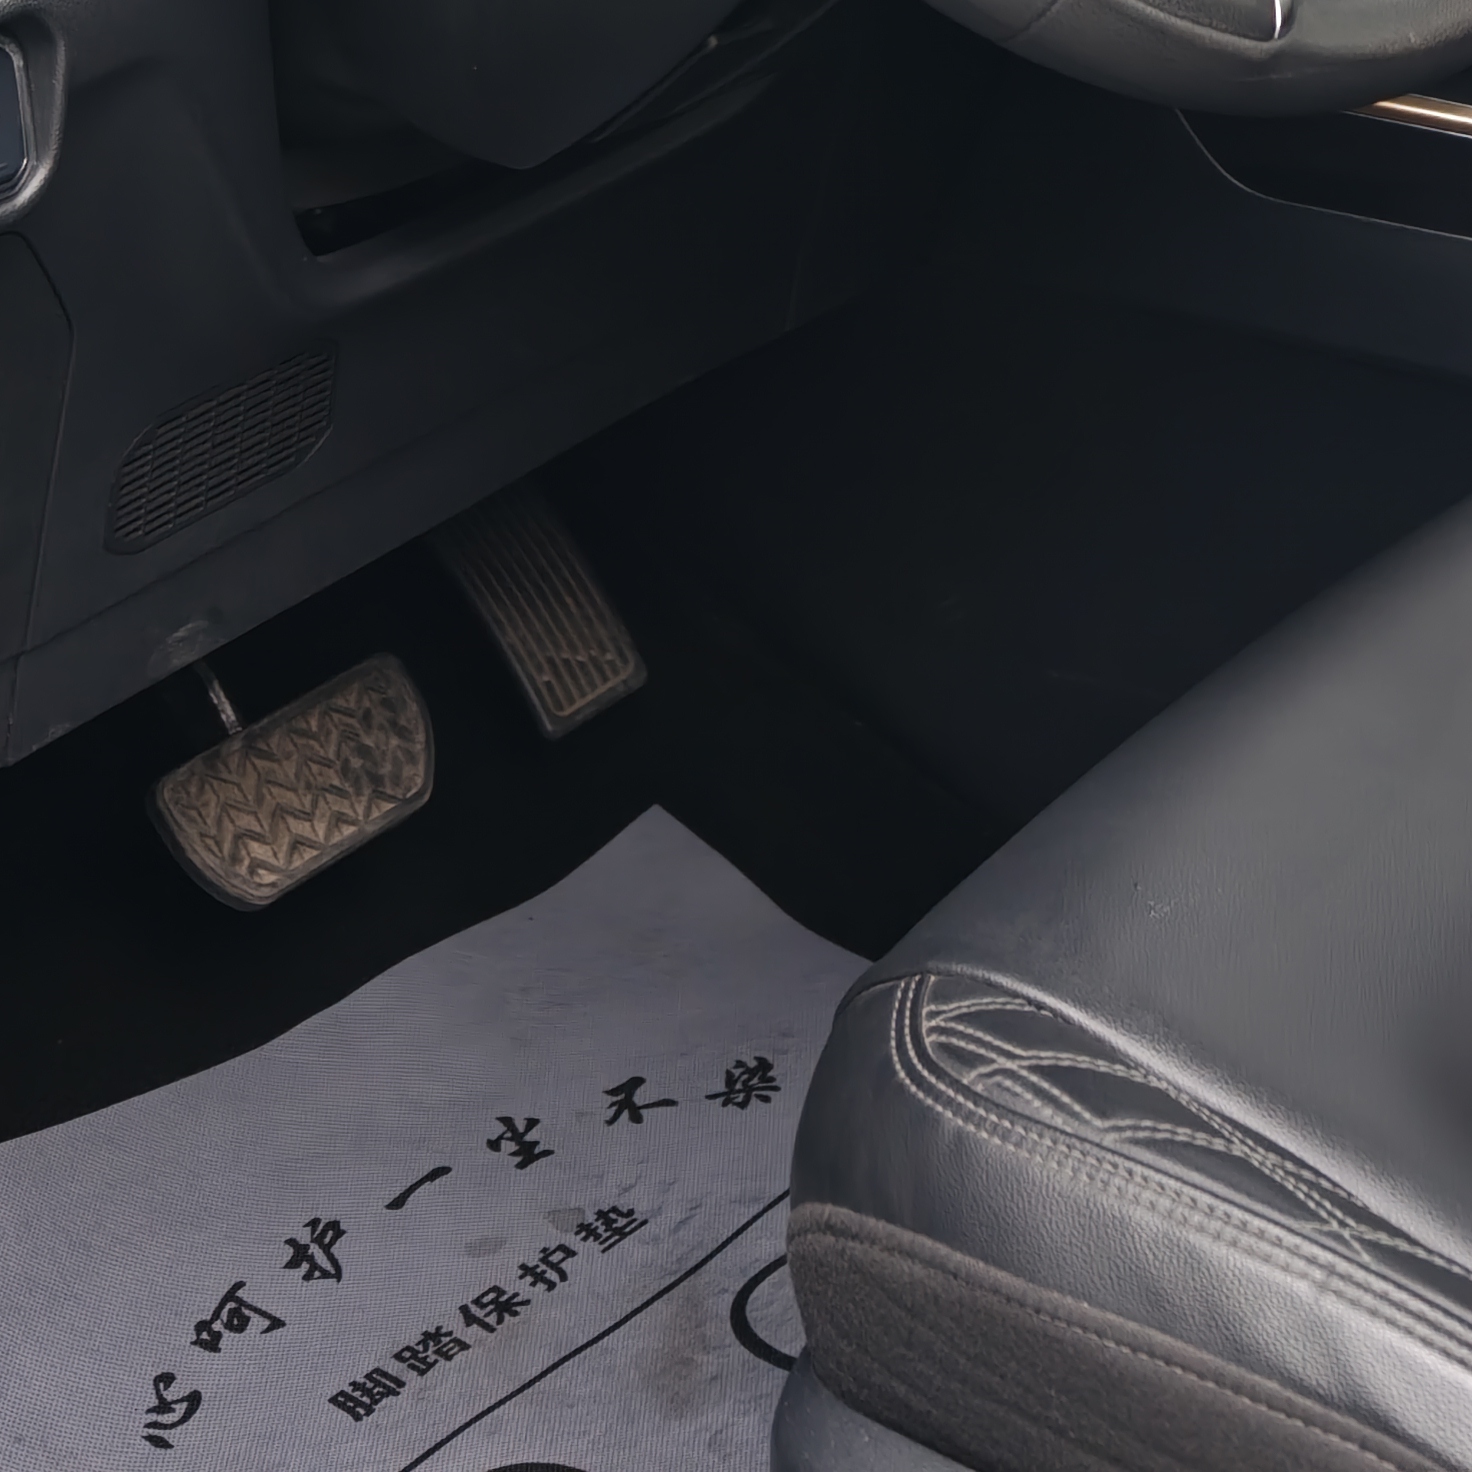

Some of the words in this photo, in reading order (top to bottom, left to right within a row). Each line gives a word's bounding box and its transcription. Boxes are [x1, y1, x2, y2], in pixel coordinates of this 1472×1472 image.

[141, 1056, 782, 1450] 心呵护一尘不染
[327, 1204, 650, 1423] 脚踏保护垫
